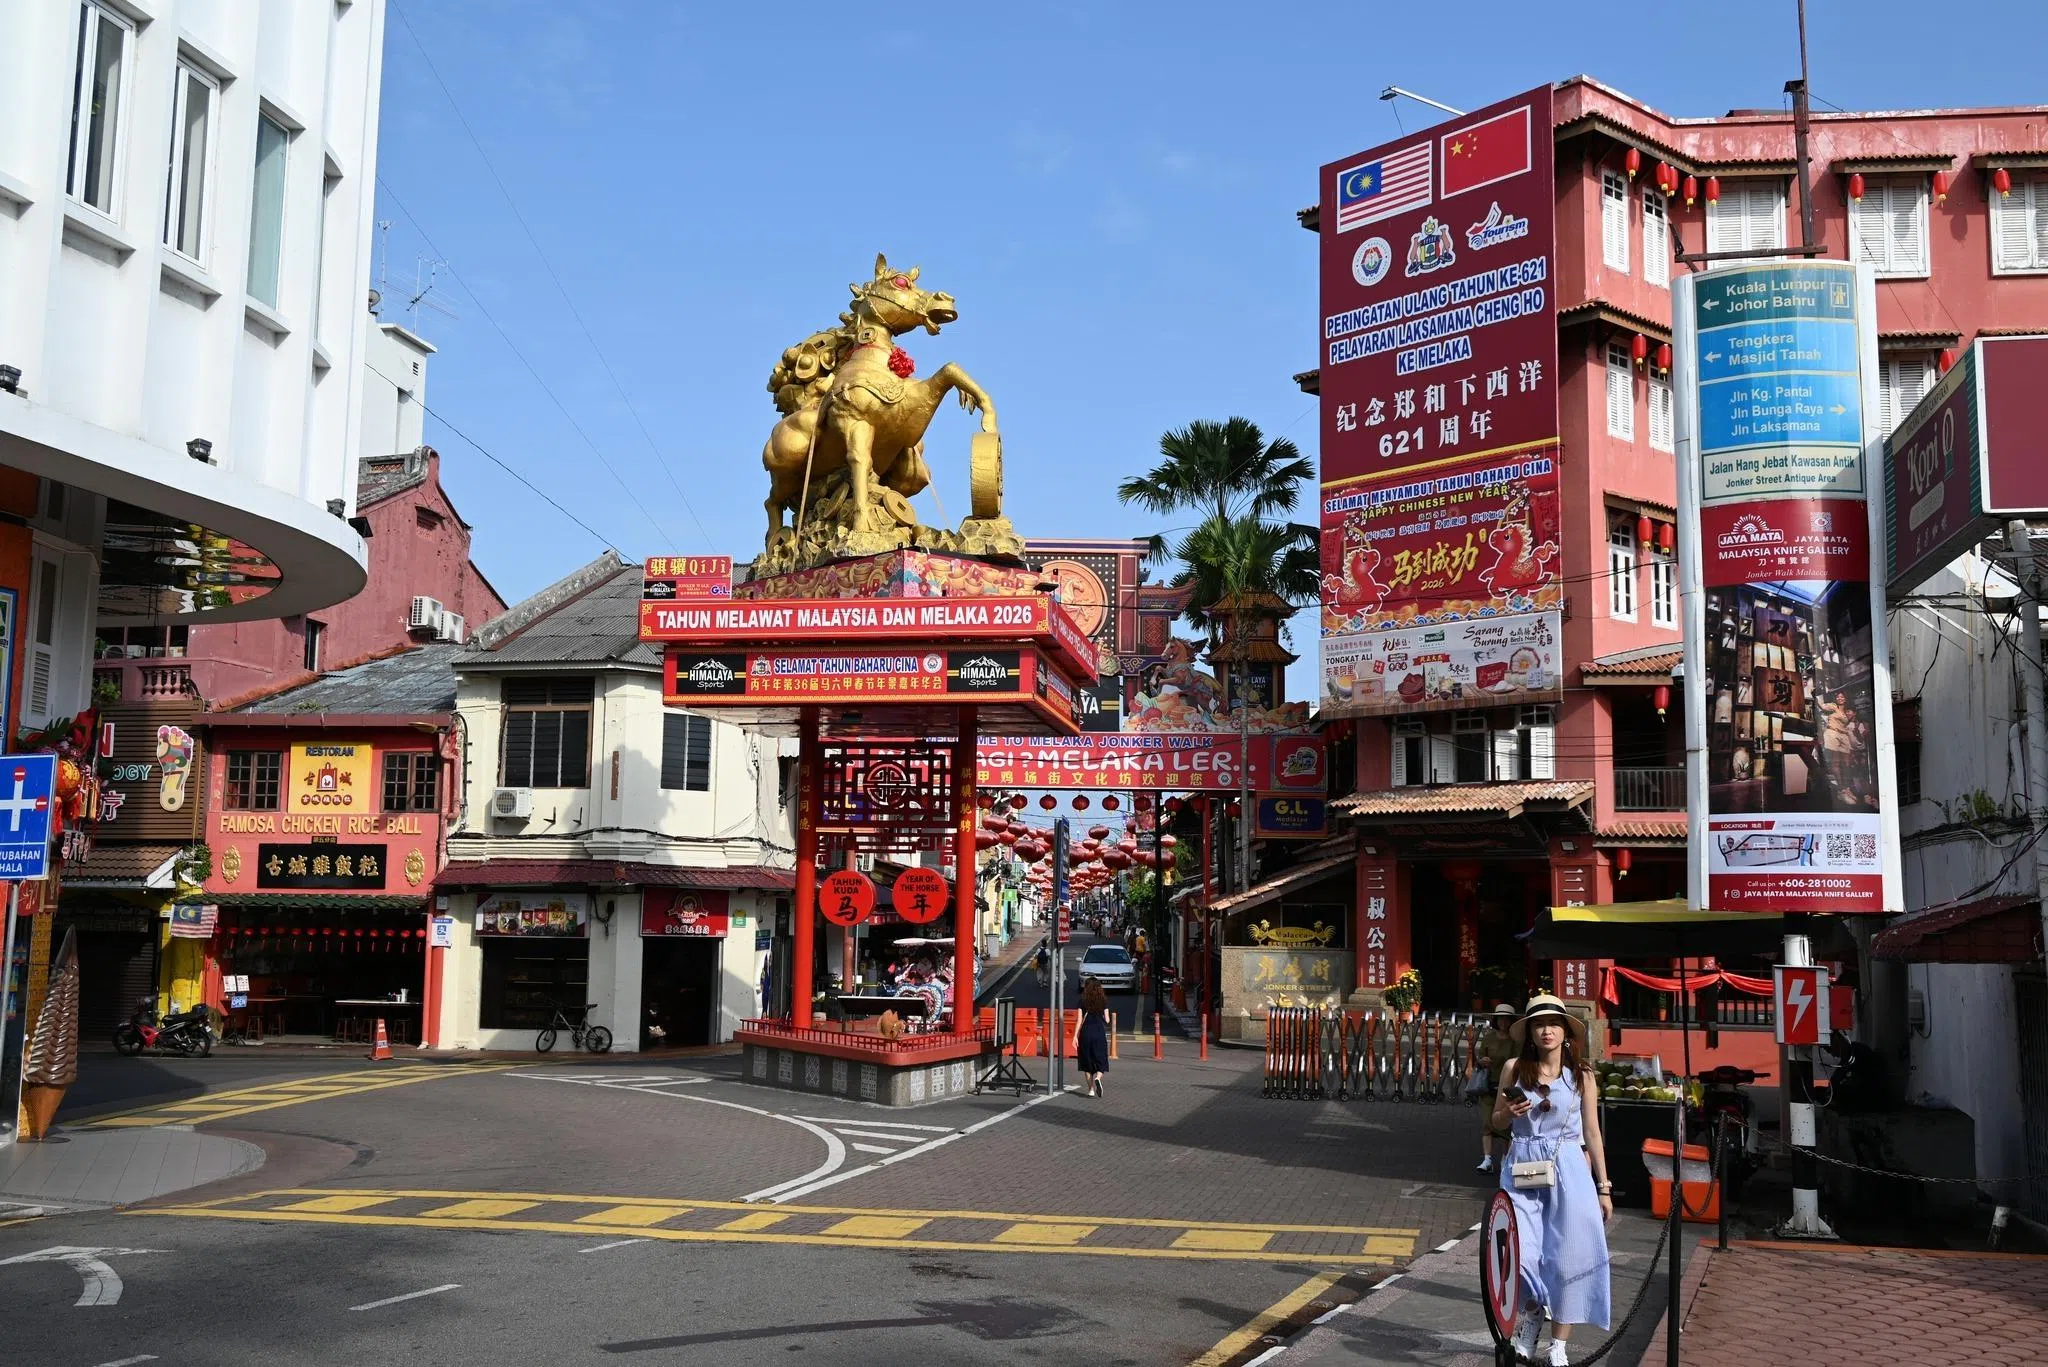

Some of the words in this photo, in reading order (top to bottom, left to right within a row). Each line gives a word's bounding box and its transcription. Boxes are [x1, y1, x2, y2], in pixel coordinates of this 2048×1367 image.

[1482, 220, 1526, 239] Tourism
[1483, 228, 1526, 244] MELAKA
[1726, 281, 1767, 297] Kuala
[1771, 279, 1825, 293] Lumpur
[1326, 299, 1401, 338] PERINGATAN
[1403, 286, 1447, 314] ULANG
[1450, 273, 1496, 302] TAHUN
[1499, 257, 1546, 287] KE-621
[1726, 297, 1768, 313] Johor
[1773, 296, 1815, 308] Bahru
[1330, 332, 1396, 365] PELAYARAN
[1398, 311, 1474, 346] LAKSAMANA
[1475, 296, 1521, 325] CHENG
[1522, 287, 1544, 313] HO
[1728, 334, 1795, 350] Tengkera
[1396, 352, 1417, 375] KE
[1417, 335, 1472, 369] MELAKA
[1729, 350, 1776, 367] Masjid
[1780, 348, 1821, 361] Tanah
[1336, 359, 1543, 432] 纪念郑和下西洋
[1729, 391, 1748, 404] Jln
[1751, 388, 1772, 401] Kg.
[1775, 386, 1812, 398] Pantai
[1730, 407, 1748, 420] Jln
[1752, 404, 1792, 418] Bunga
[1795, 403, 1824, 416] Raya
[1379, 426, 1424, 458] 621
[1439, 410, 1492, 448] 周年
[1731, 424, 1749, 437] Jln
[1752, 421, 1821, 434] Laksamana
[1709, 459, 1734, 475] Jalan
[1735, 457, 1760, 473] Hang
[1762, 455, 1789, 468] Jebat
[1791, 455, 1831, 468] Kawasan
[1833, 455, 1855, 469] Antik
[1907, 423, 1939, 496] Kopi
[1325, 494, 1369, 513] SELAMAT
[1371, 481, 1434, 503] MENYAMBUT
[1436, 475, 1471, 492] TAHUN
[1474, 466, 1520, 486] BAHARU
[1522, 458, 1552, 475] CINA
[1725, 477, 1753, 488] Jonker
[1755, 475, 1782, 485] Street
[1784, 473, 1816, 484] Antique
[1818, 473, 1837, 483] Area
[1361, 506, 1395, 520] HAPPY
[1400, 497, 1445, 513] CHINESE
[1450, 492, 1473, 504] NEW
[1479, 484, 1509, 499] YEAR
[1719, 533, 1748, 546] JAYA
[1750, 531, 1782, 542] MATA
[1794, 535, 1820, 543] JAYA
[1388, 532, 1479, 589] 马到成功
[1718, 547, 1771, 560] MALAYSIA
[1773, 546, 1804, 555] KNIFE
[1807, 546, 1850, 555] GALLERY
[1746, 570, 1773, 579] Jonker
[1775, 569, 1794, 577] Walk
[1796, 568, 1828, 577] Malacca
[711, 585, 730, 595] G.L.
[1421, 579, 1444, 591] 2026
[657, 610, 711, 629] TAHUN
[716, 609, 792, 628] MELAWAT
[797, 608, 878, 627] MALAYSIA
[883, 607, 916, 626] DAN
[921, 606, 989, 625] MELAKA
[993, 605, 1032, 624] 2026
[1463, 625, 1504, 640] Sarang
[1472, 636, 1508, 648] Burung
[774, 657, 817, 674] SELAMAT
[819, 657, 852, 673] TAHUN
[854, 656, 892, 673] BAHARU
[894, 656, 918, 673] CINA
[1326, 655, 1360, 665] TONGKAT
[689, 670, 733, 681] HIMALAYA
[960, 667, 1006, 679] HIMALAYA
[697, 681, 725, 690] Sports
[968, 678, 997, 689] Sports
[1004, 736, 1024, 747] TO
[1029, 735, 1094, 748] MELAKA
[1099, 736, 1163, 748] JONKER
[1168, 736, 1213, 749] WALK
[305, 746, 354, 757] RESTORAN
[978, 771, 1204, 786] 甲鸡场街文化坊欢迎您
[1275, 800, 1308, 815] G.L.
[220, 815, 275, 833] FAMOSA
[281, 816, 341, 834] CHICKEN
[347, 816, 379, 834] RICE
[386, 817, 422, 834] BALL
[0, 850, 41, 860] UBAHAN
[832, 878, 863, 886] TAHUN
[905, 875, 924, 883] YEAR
[925, 875, 934, 883] OF
[1778, 879, 1852, 888] +606-2810002
[834, 886, 859, 894] KUDA
[901, 884, 915, 892] THE
[916, 884, 941, 892] HORSE
[834, 896, 858, 921] 马
[909, 894, 932, 918] 年
[1367, 868, 1386, 950] 三叔公
[1378, 954, 1386, 985] 有限公司
[1578, 962, 1586, 997] 有限公司
[231, 998, 247, 1008] OPEN
